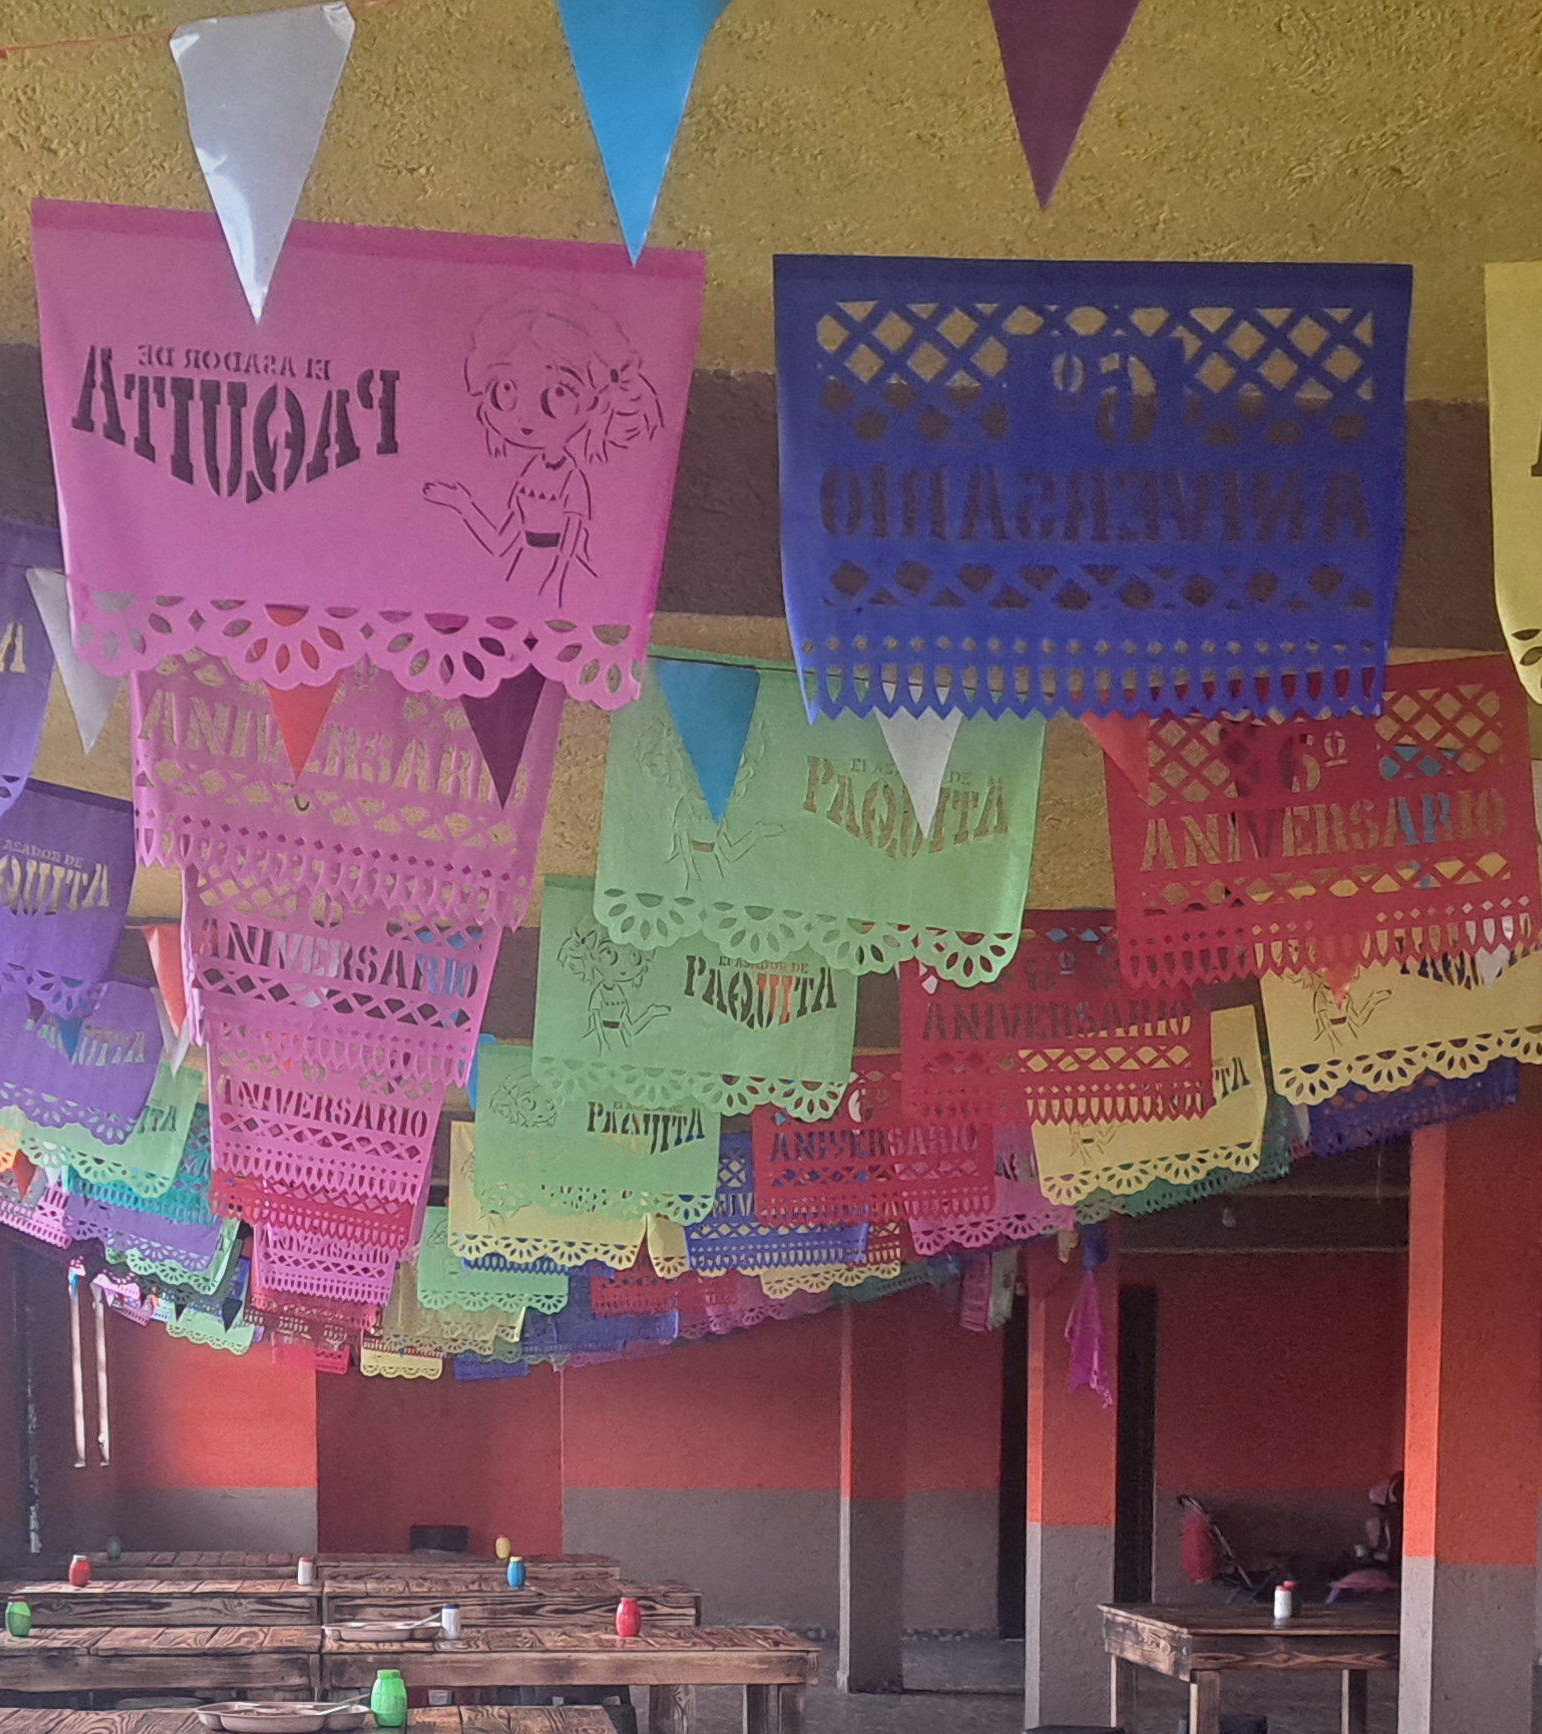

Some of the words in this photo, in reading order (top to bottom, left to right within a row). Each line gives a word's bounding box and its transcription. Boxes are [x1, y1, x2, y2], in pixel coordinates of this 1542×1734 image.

[803, 755, 1008, 859] PAQUITA
[1141, 787, 1506, 873] ANIVERSARIO
[194, 917, 479, 999] ANIVERSARIO
[683, 954, 838, 1031] PAQUITA
[923, 1000, 1192, 1041] ANIVERSARIO
[216, 1074, 428, 1138] ANIVERSARIO
